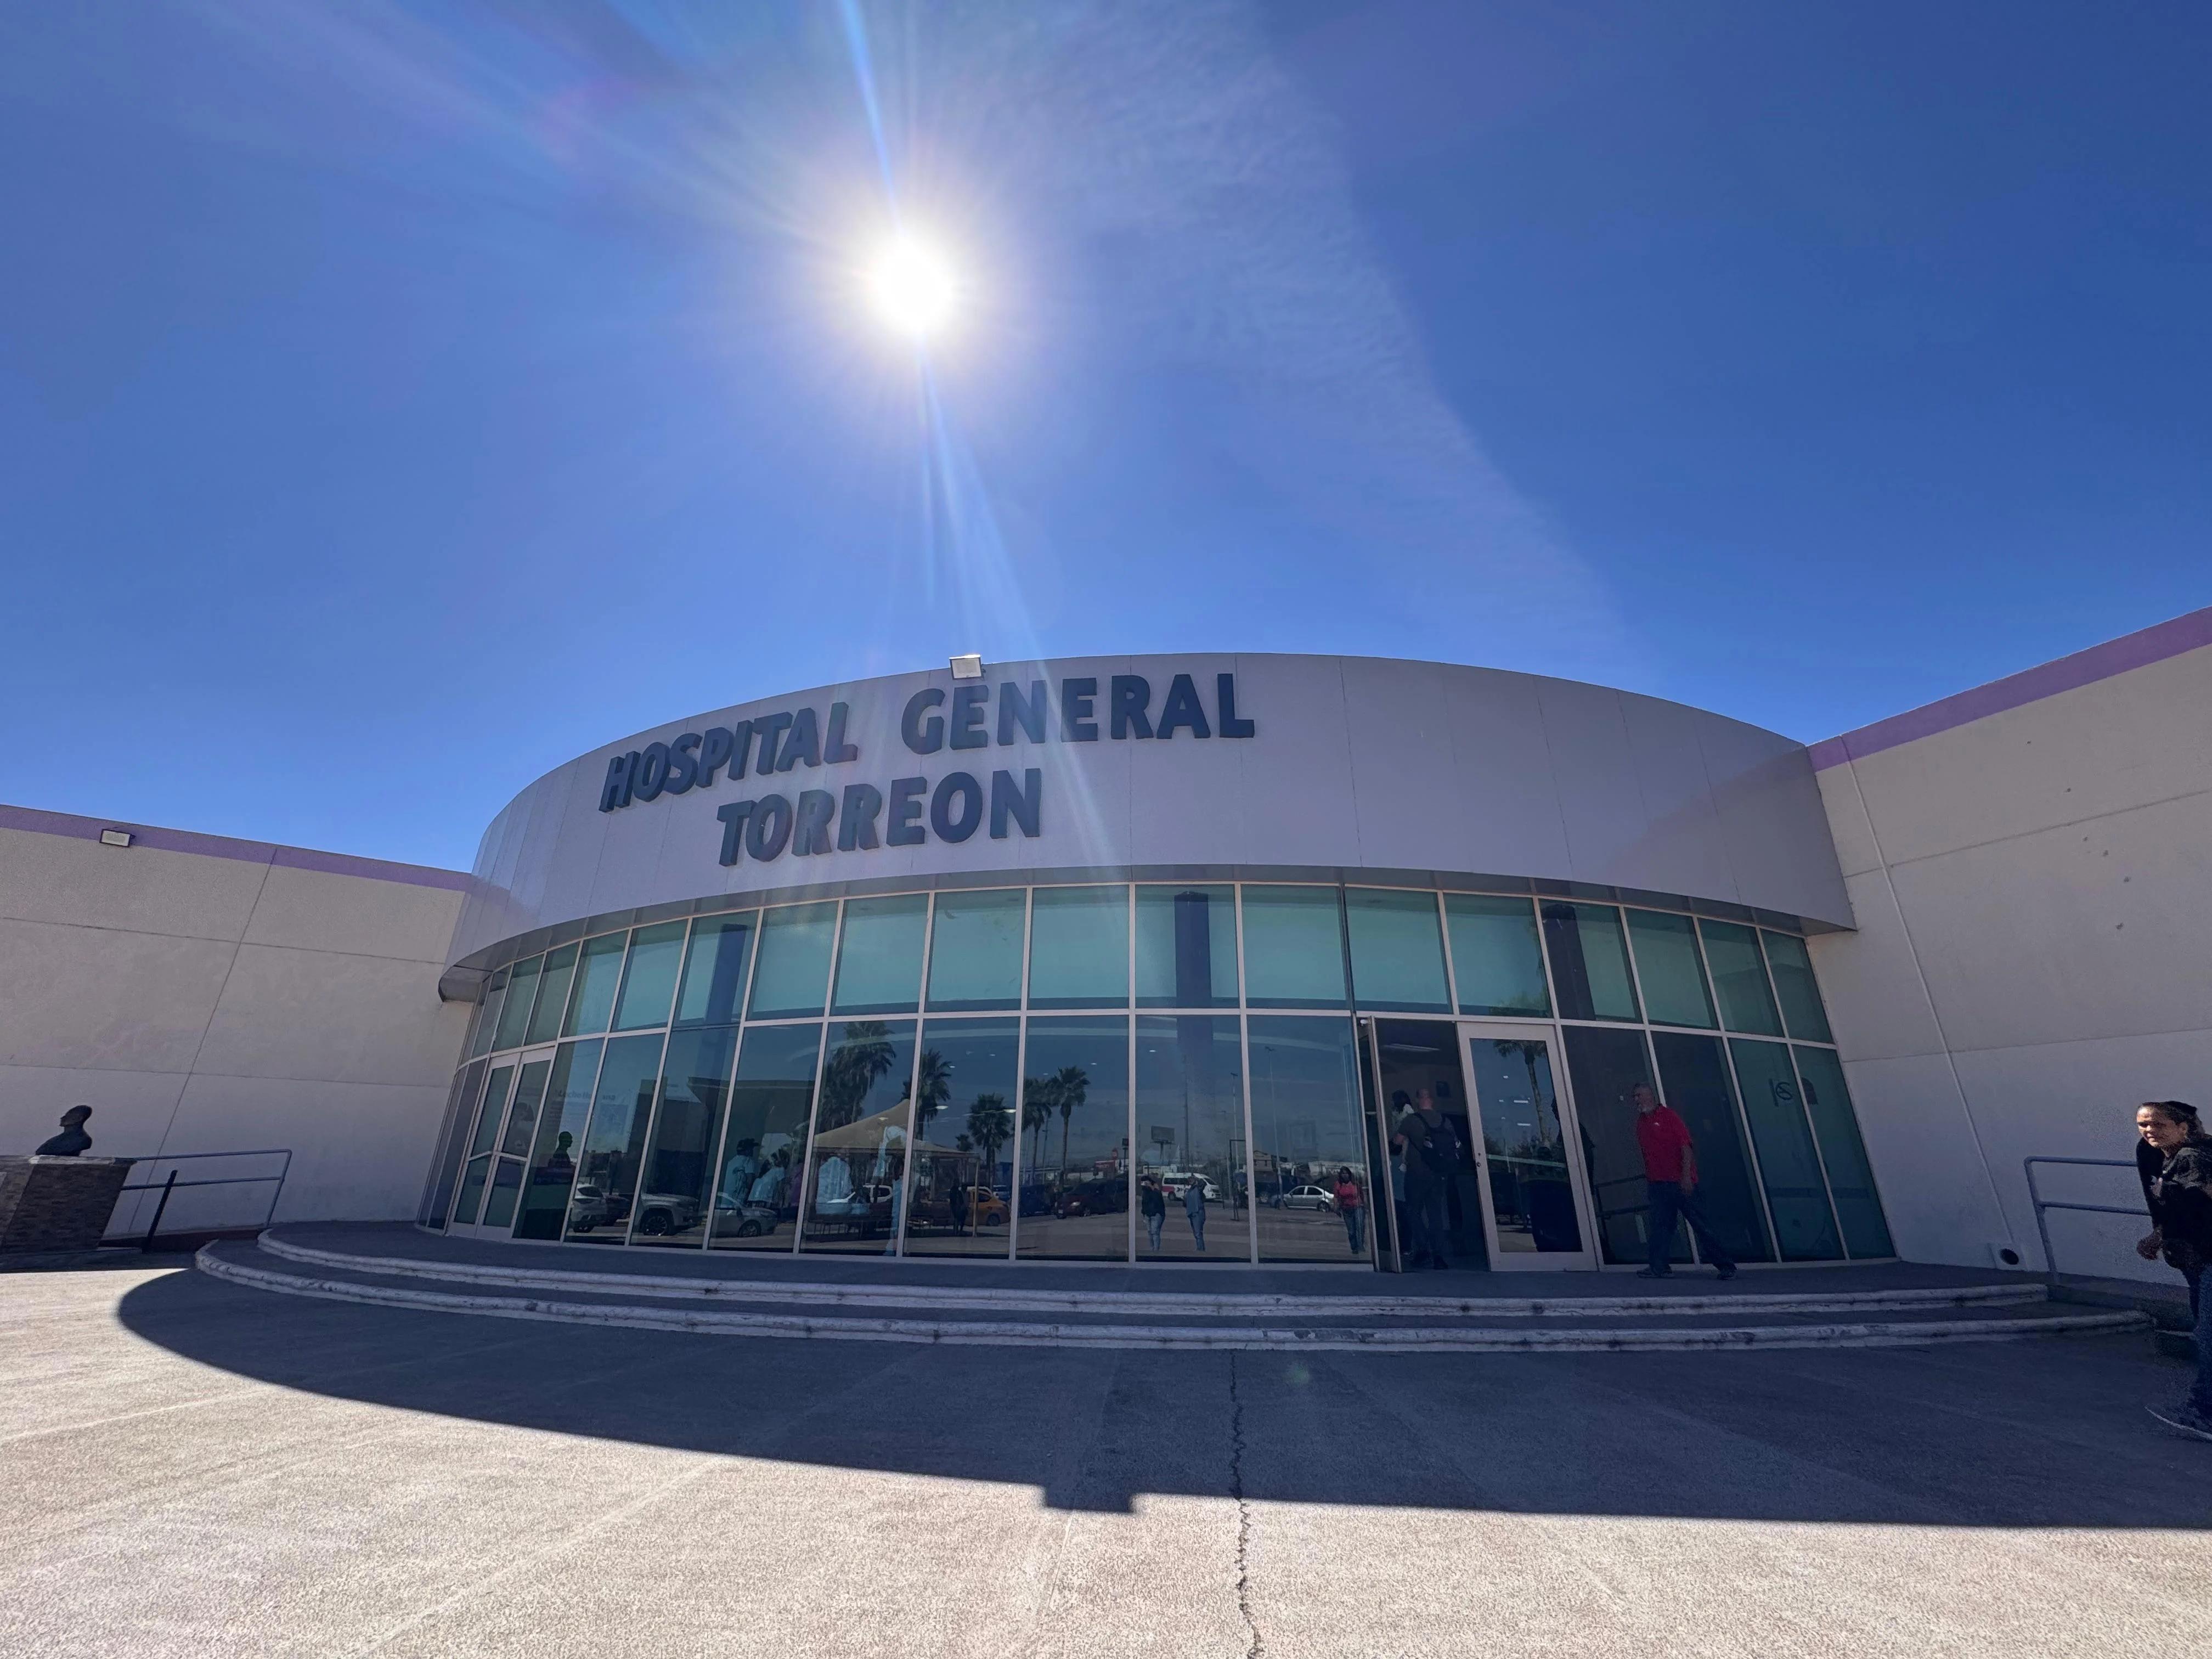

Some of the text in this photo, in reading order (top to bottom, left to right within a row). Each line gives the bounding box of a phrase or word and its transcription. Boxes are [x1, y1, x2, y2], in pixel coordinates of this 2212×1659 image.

[599, 673, 1255, 813] HOSPITAL GENERAL
[716, 768, 1041, 867] TORREON
